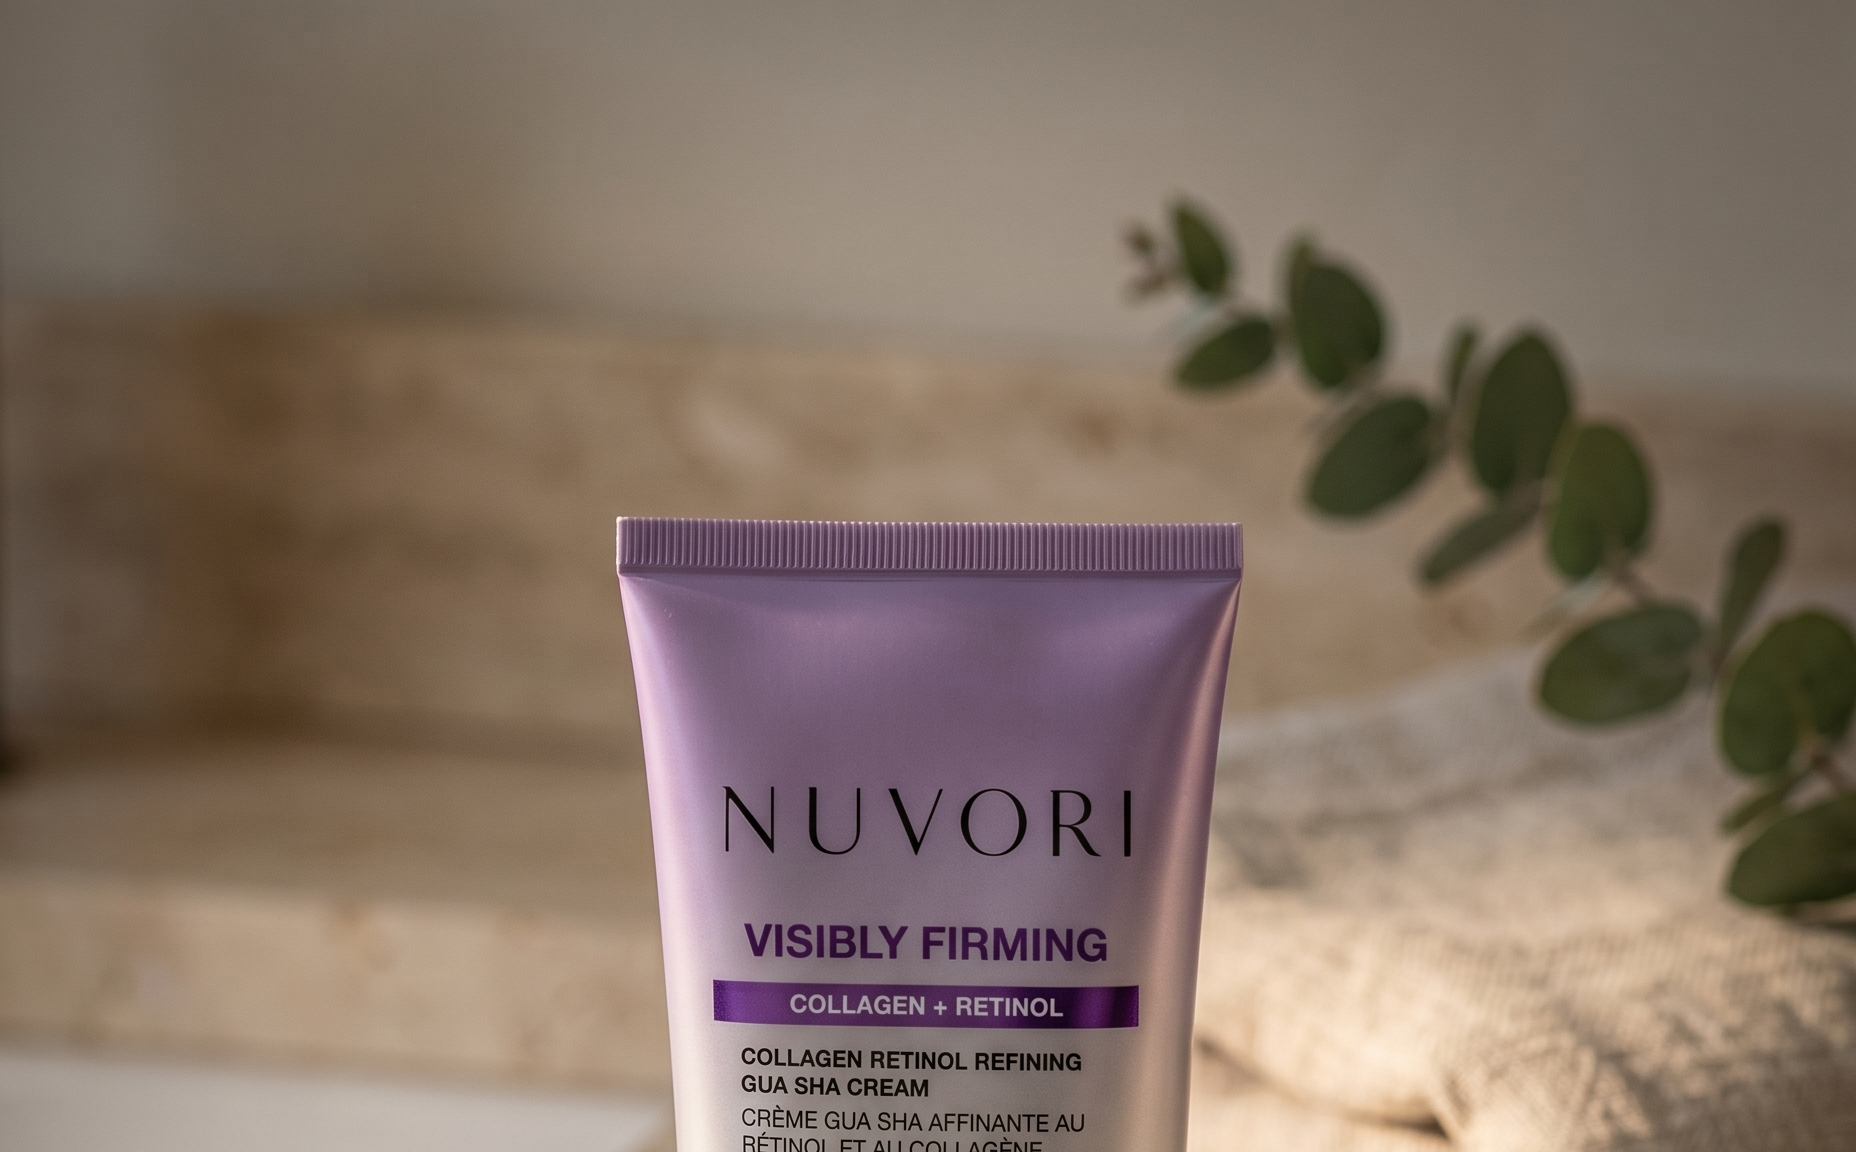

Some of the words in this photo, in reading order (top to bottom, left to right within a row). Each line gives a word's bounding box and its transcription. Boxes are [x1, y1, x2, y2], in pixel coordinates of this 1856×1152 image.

[722, 786, 1131, 857] NUVORI
[745, 924, 908, 959] VISIBLY
[923, 927, 1107, 962] FIRMING
[790, 994, 924, 1015] COLLAGEN
[934, 1001, 947, 1015] +
[957, 997, 1063, 1016] RETINOL
[742, 1048, 861, 1068] COLLAGEN
[871, 1051, 967, 1070] RETINOL
[976, 1053, 1081, 1071] REFINING
[742, 1075, 788, 1094] GUA
[795, 1077, 840, 1095] SHA
[847, 1078, 928, 1097] CREAM
[742, 1105, 817, 1129] CRÈME
[825, 1111, 871, 1130] GUA
[878, 1112, 922, 1131] SHA
[929, 1114, 1048, 1132] AFFINANTE
[1055, 1114, 1084, 1132] AU
